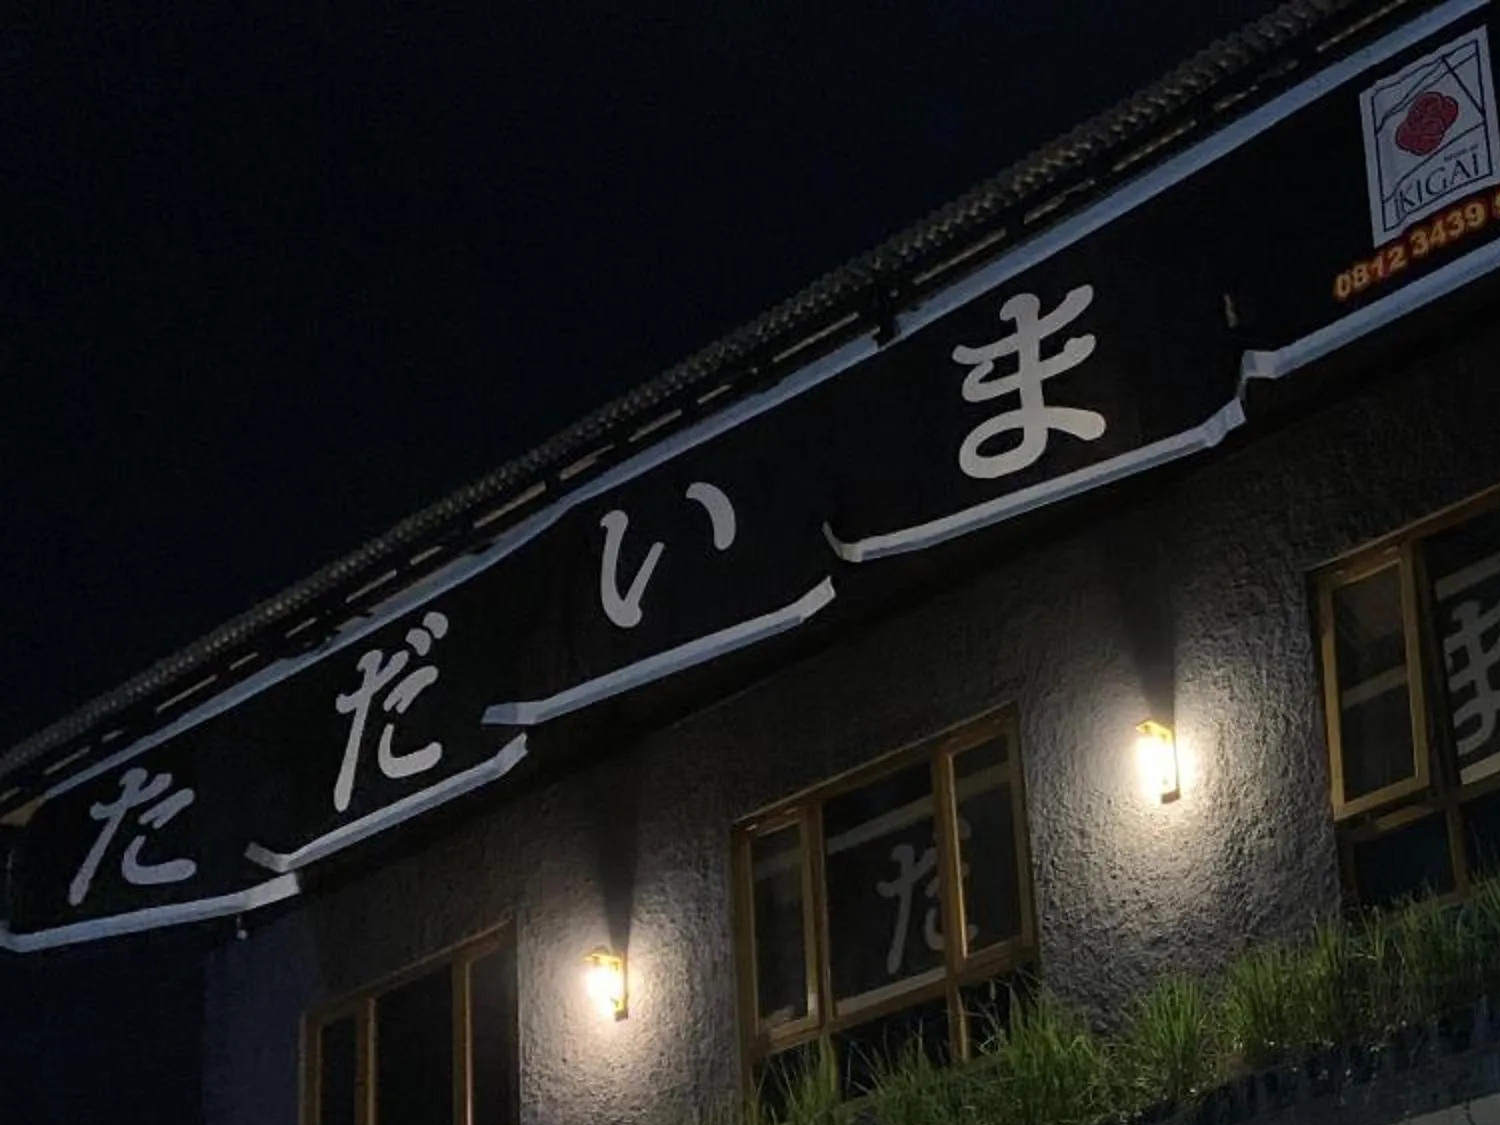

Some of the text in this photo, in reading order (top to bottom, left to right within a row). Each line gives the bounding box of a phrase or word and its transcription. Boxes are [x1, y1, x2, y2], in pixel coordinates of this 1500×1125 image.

[1334, 243, 1408, 300] 0812
[1409, 201, 1487, 257] 3439
[67, 284, 1107, 906] ただいま
